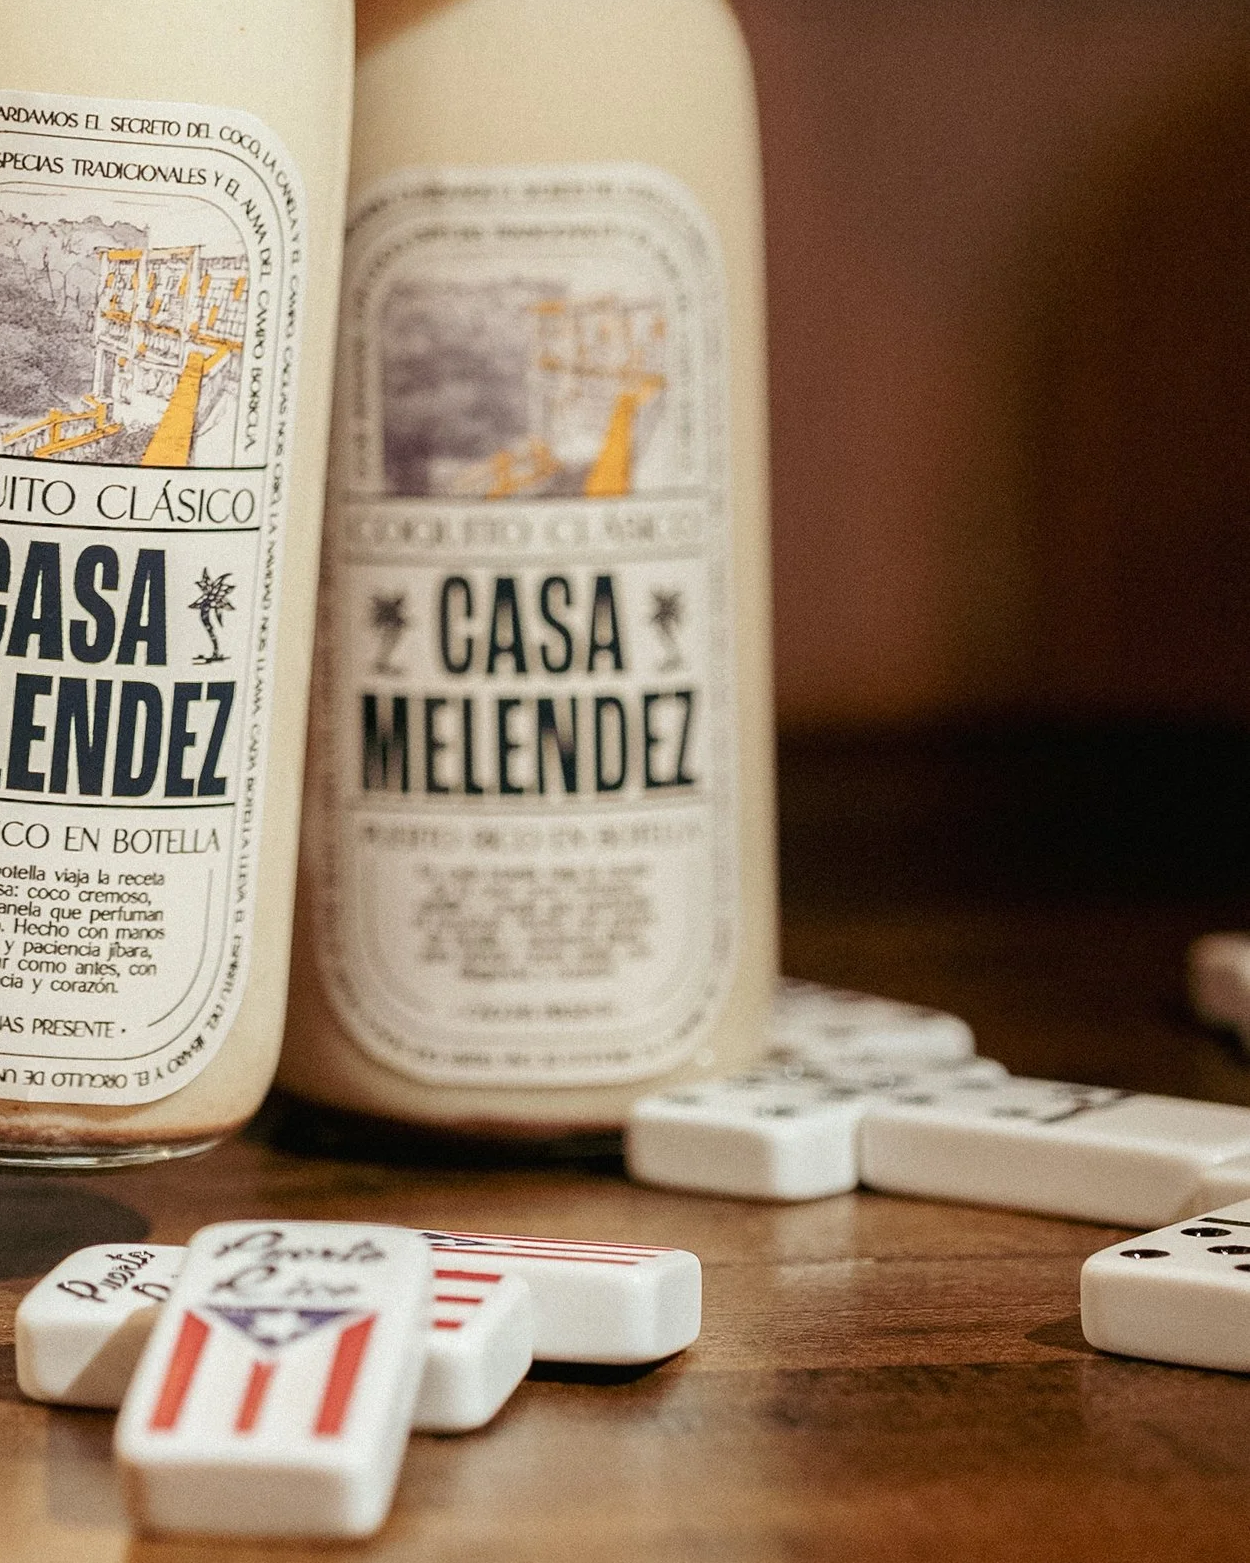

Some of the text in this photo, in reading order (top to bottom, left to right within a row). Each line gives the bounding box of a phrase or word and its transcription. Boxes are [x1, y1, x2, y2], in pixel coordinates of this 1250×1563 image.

[84, 113, 104, 131] EL
[110, 116, 181, 137] SECRETO
[186, 122, 215, 139] DEL
[219, 125, 261, 159] COCO,
[71, 158, 207, 185] TRADICIONALES
[213, 170, 224, 188] Y
[224, 178, 241, 202] EL
[96, 479, 255, 524] CLÁSICO
[439, 575, 624, 674] CASA
[362, 689, 696, 795] MELENDEZ
[64, 825, 101, 853] EN
[112, 827, 222, 855] BOTELLA
[54, 868, 90, 888] viaja
[97, 869, 110, 886] la
[117, 872, 165, 887] receta
[27, 886, 70, 902] coco
[78, 889, 152, 906] cremoso,
[50, 906, 83, 923] que
[89, 905, 165, 925] perfuman
[13, 917, 70, 938] Hecho
[77, 925, 109, 939] con
[115, 926, 166, 940] manos
[4, 939, 16, 956] y
[22, 940, 101, 957] paciencia
[17, 958, 67, 974] como
[74, 960, 121, 978] antes,
[128, 962, 158, 977] con
[31, 977, 43, 995] y
[50, 976, 119, 995] corazón.
[31, 1017, 116, 1039] PRESENTE
[23, 1069, 45, 1086] DE
[51, 1072, 128, 1089] ORGULLO
